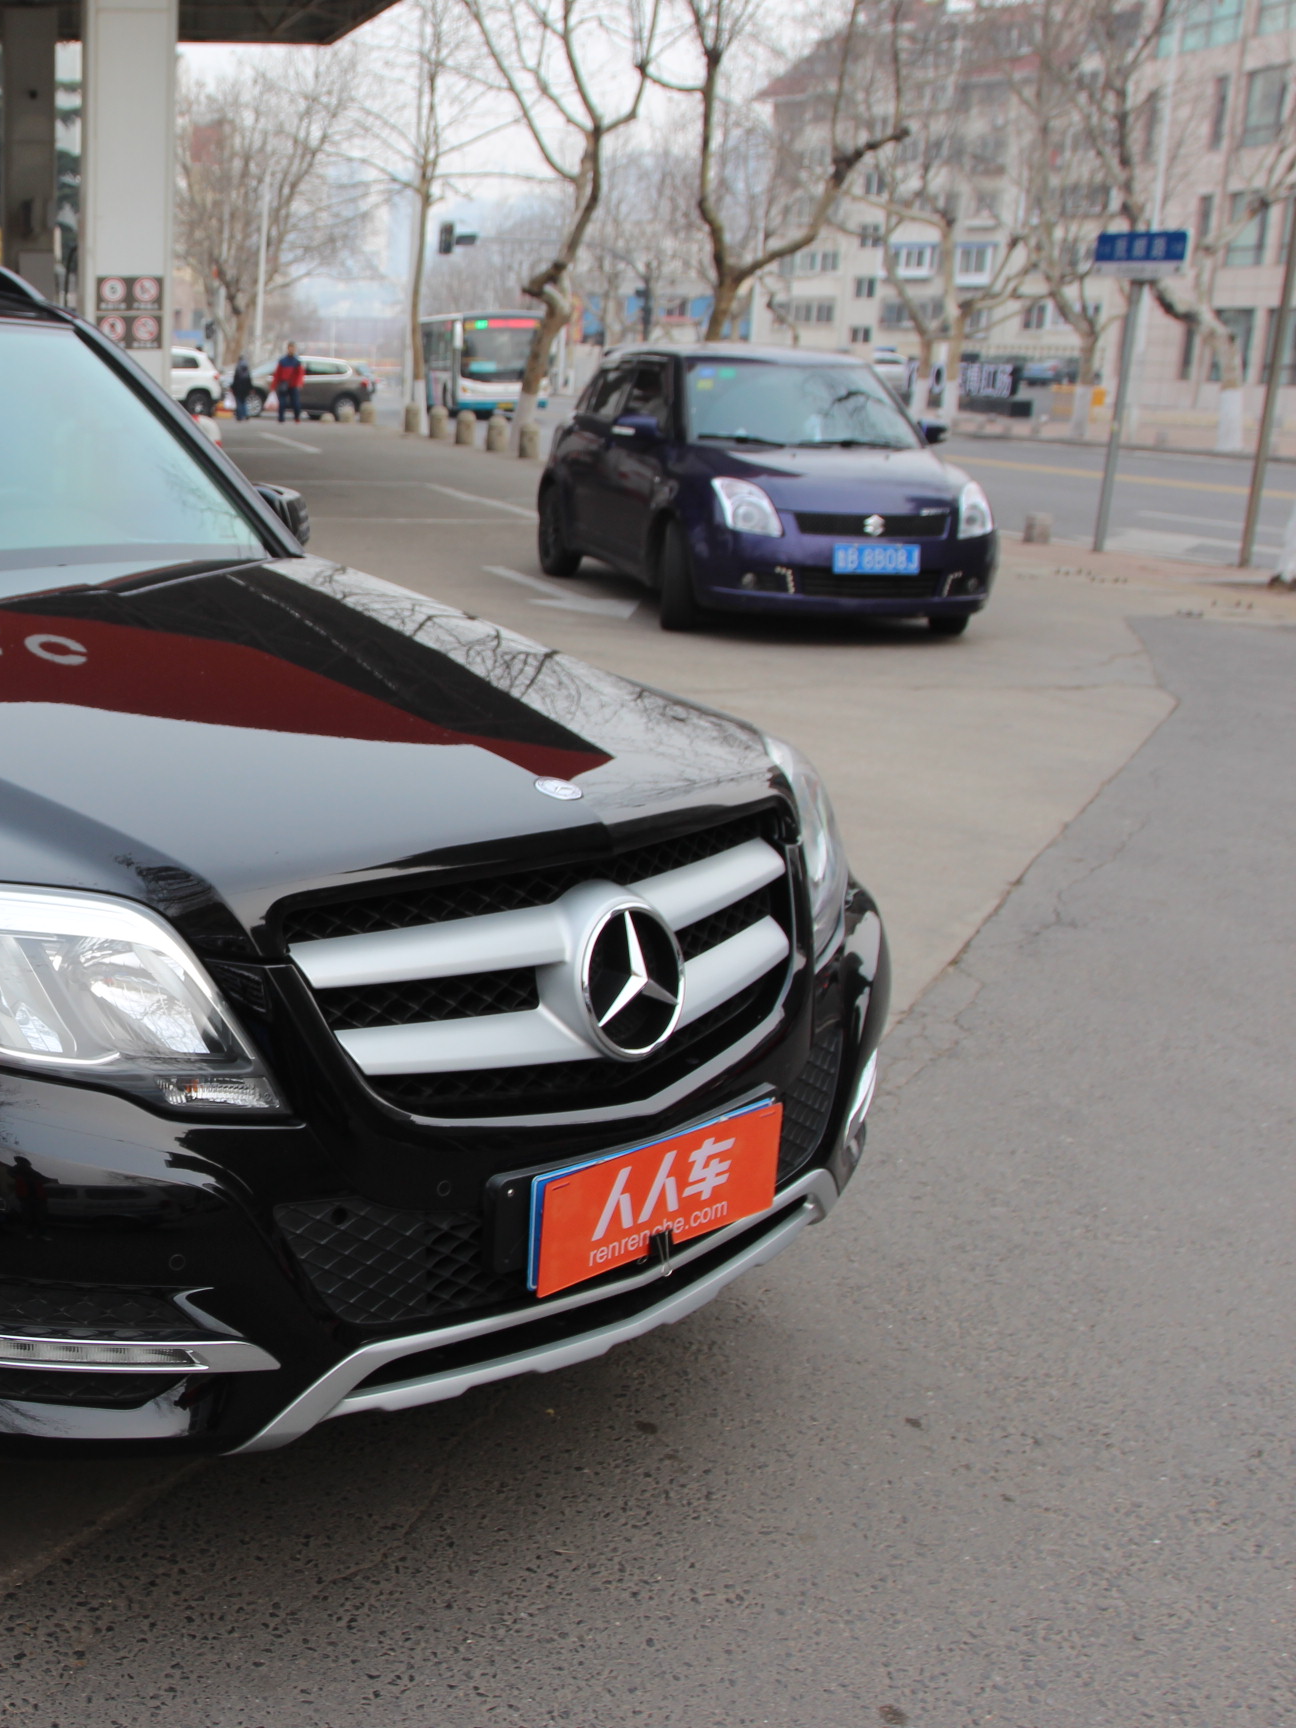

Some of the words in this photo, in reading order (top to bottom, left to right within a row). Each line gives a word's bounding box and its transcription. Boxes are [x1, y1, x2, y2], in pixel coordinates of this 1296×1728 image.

[591, 1137, 736, 1242] 人人车
[588, 1201, 728, 1267] renrenche.com
